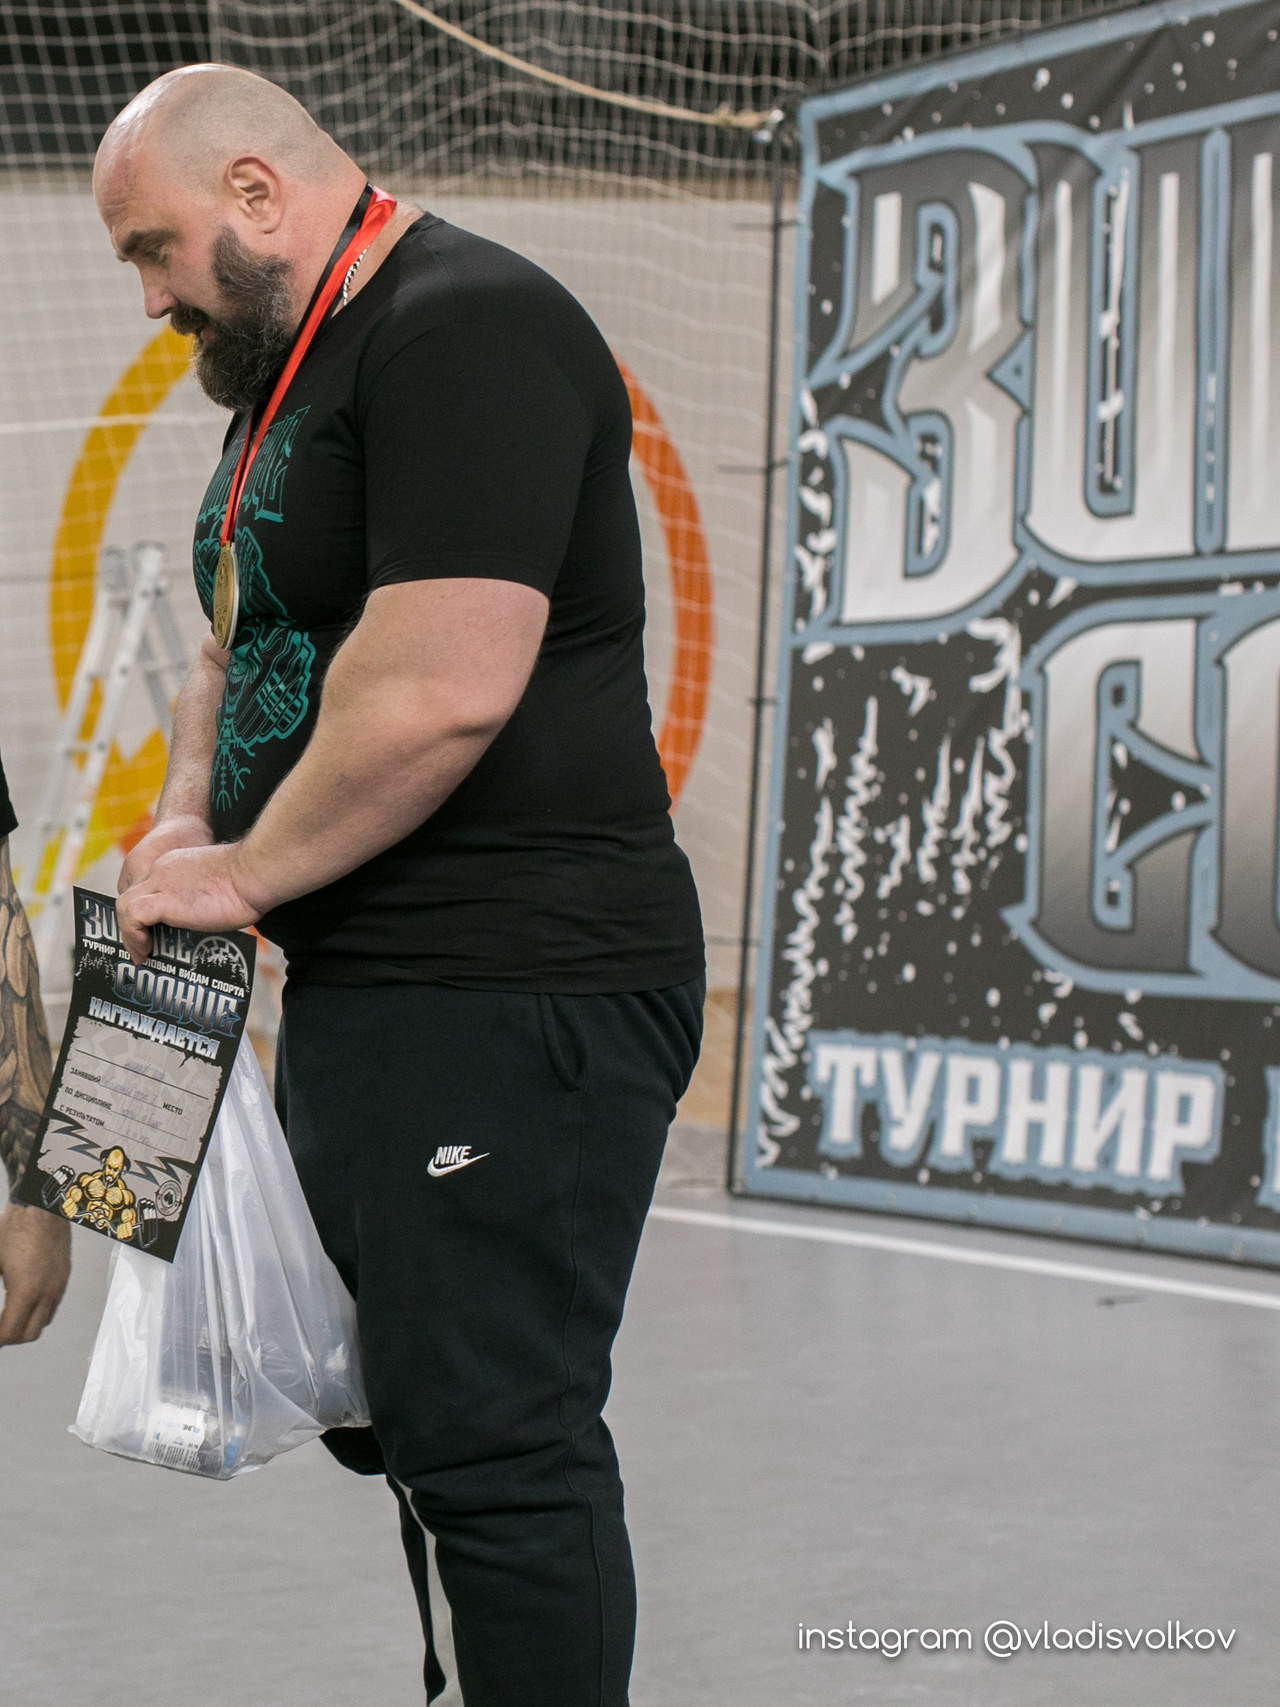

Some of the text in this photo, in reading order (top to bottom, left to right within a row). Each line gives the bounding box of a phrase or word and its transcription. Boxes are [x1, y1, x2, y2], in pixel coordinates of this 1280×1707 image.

[83, 938, 245, 998] ТУРНИР ПО ЛОВЫМ ВИДАМ СПОРТА
[88, 996, 220, 1060] НАГРАЖДАЕТСЯ
[64, 1086, 73, 1095] ПО
[74, 1088, 112, 1110] ДИСЦИПЛИНЕ
[70, 1067, 183, 1116] ЗАНЯВШИЙ МЕСТО
[808, 1036, 1221, 1190] ТУРНИР
[65, 1106, 105, 1127] РЕЗУЛЬТАТОМ
[435, 1146, 472, 1165] NIKE
